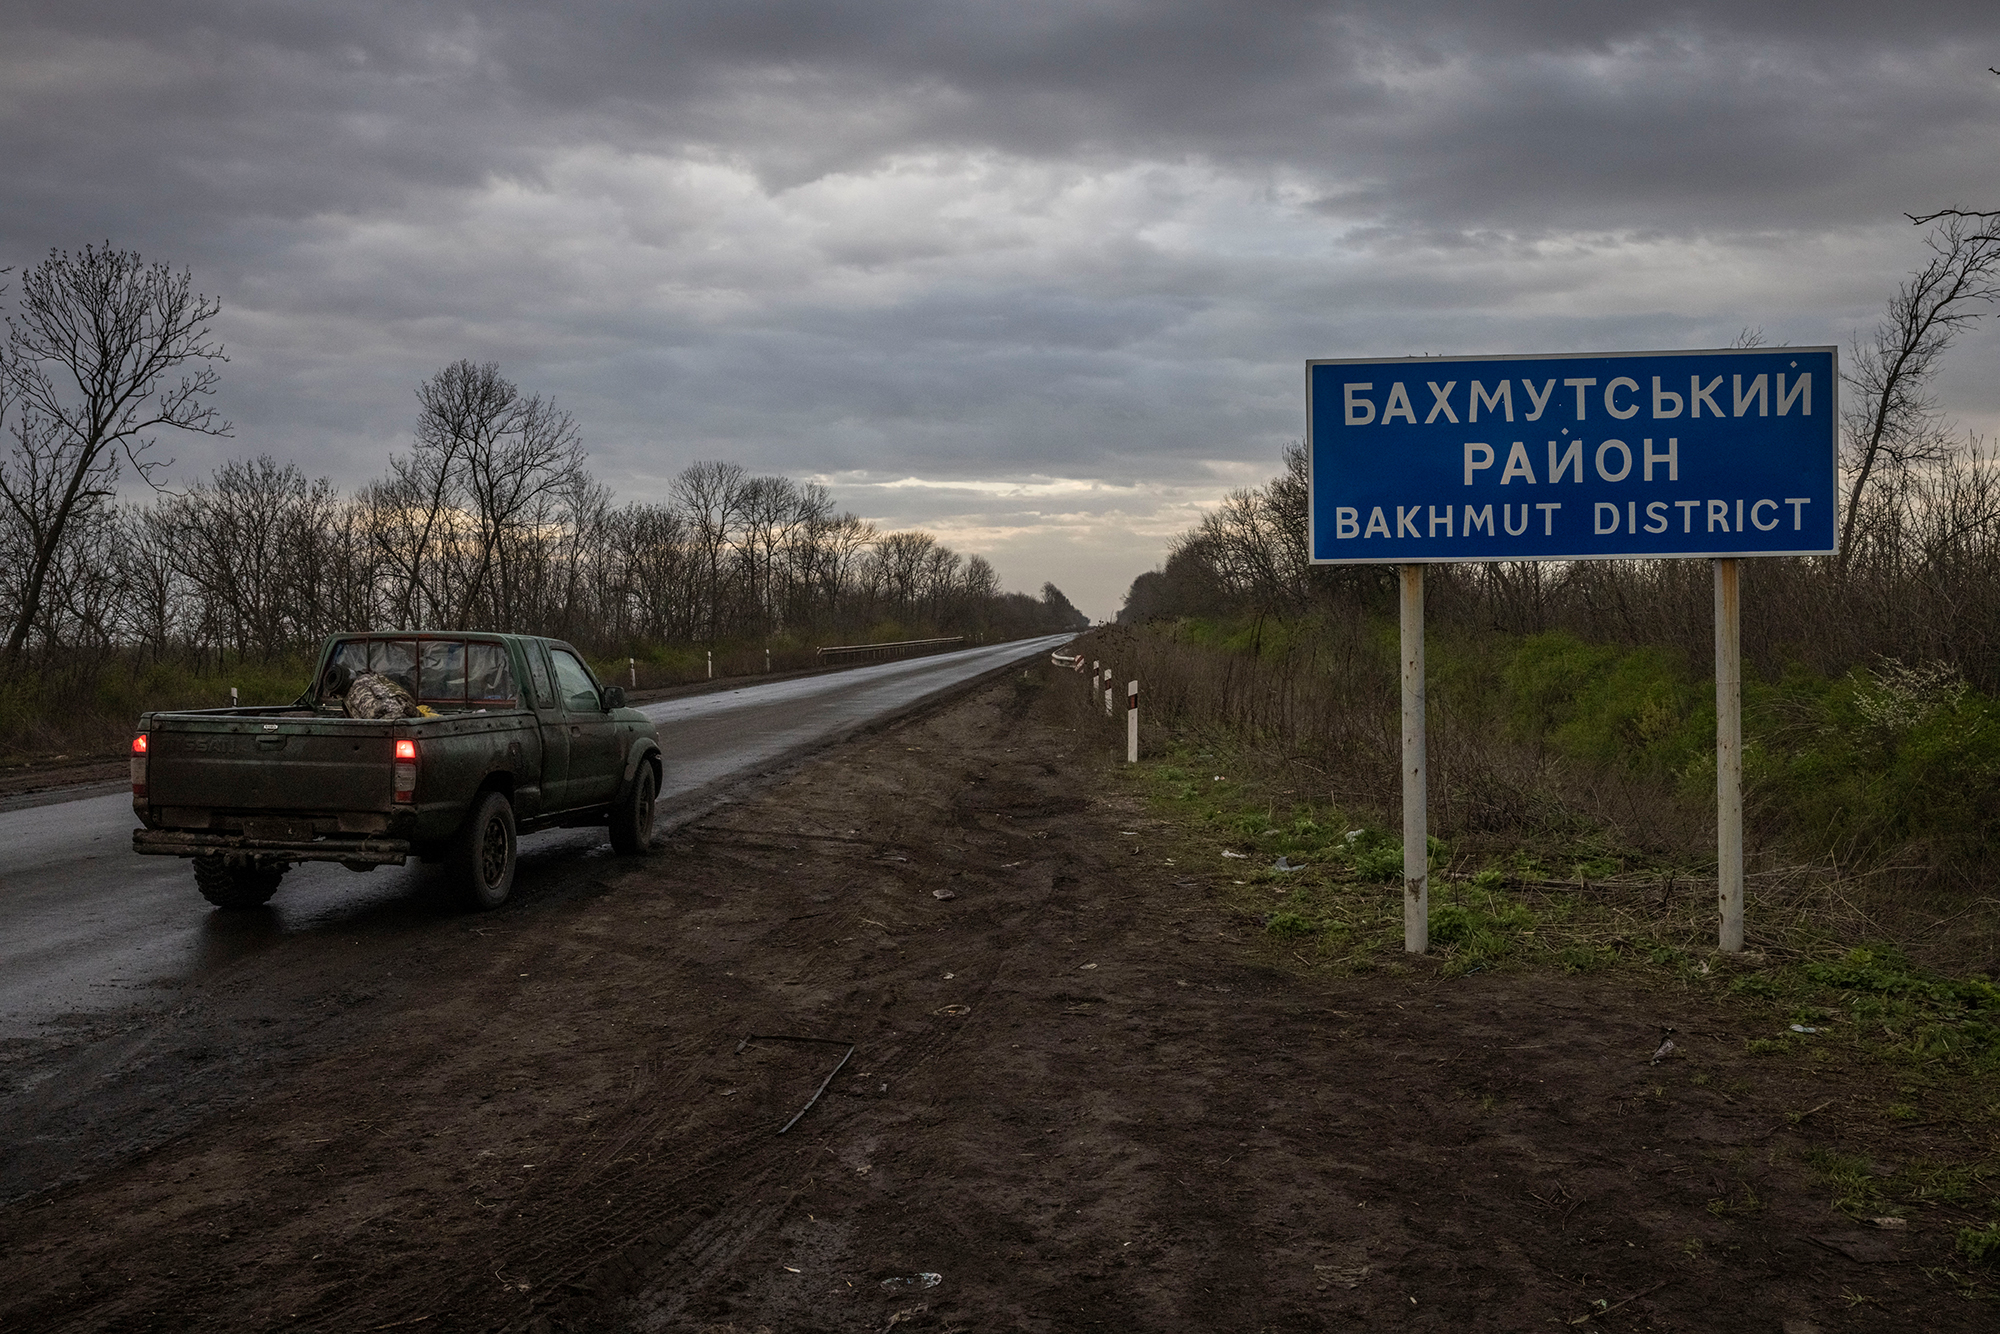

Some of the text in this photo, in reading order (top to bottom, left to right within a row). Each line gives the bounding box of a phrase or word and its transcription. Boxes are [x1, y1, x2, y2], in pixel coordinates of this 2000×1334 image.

[1343, 360, 1813, 426] БАХМУТСЬКИЙ
[1464, 428, 1679, 486] РАЙОН
[1336, 497, 1811, 539] BAKHMUT DISTRICT
